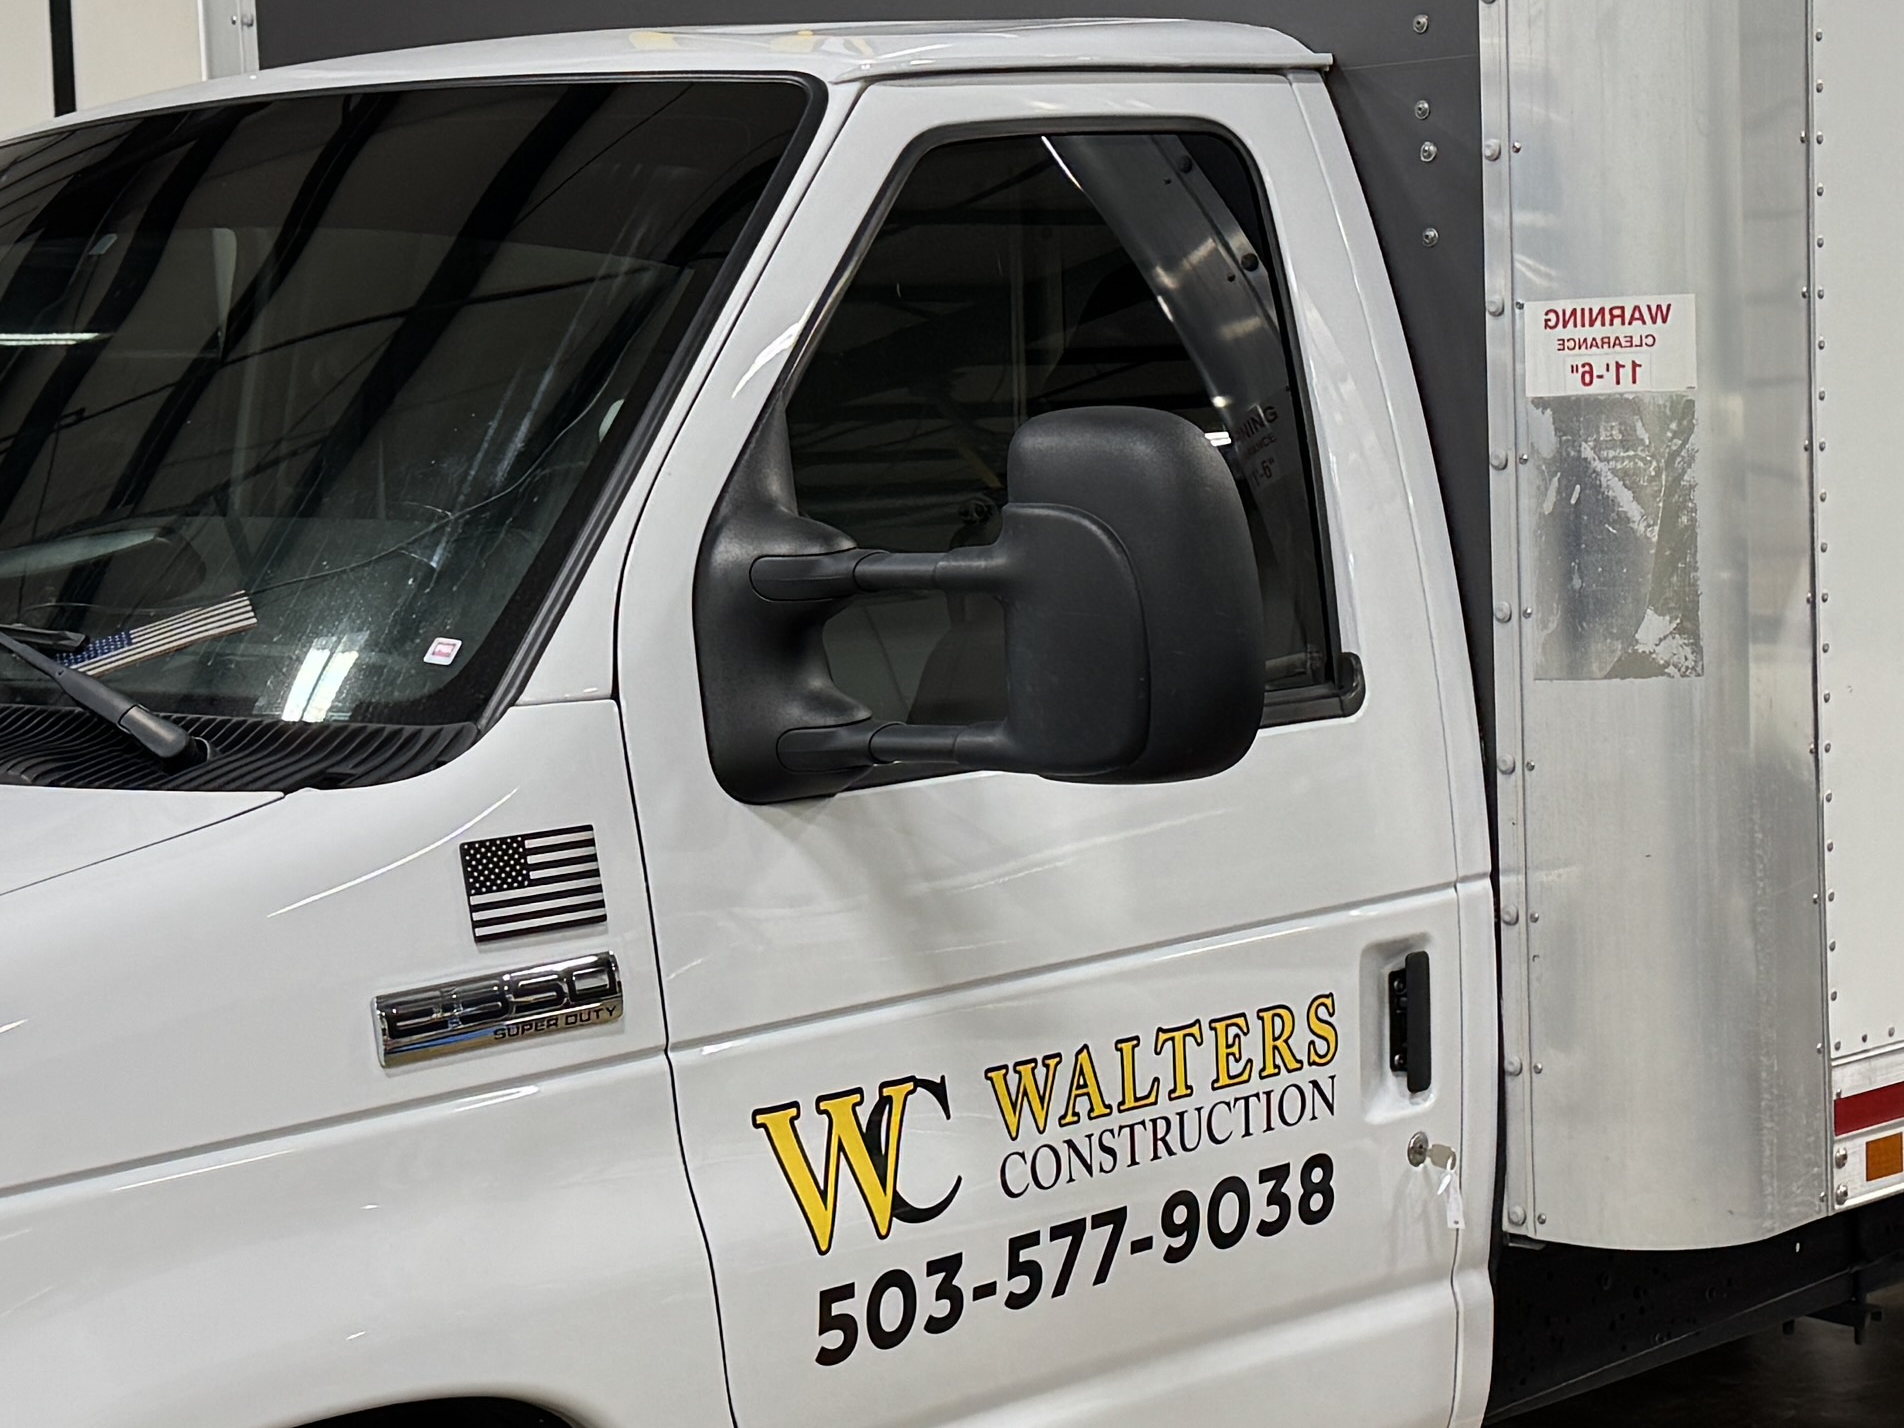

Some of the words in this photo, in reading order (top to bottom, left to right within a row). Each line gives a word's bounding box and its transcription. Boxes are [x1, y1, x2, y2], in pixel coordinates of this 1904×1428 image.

[492, 1015, 559, 1041] SUPER
[564, 1005, 618, 1026] DUTY
[984, 991, 1340, 1142] WALTERS
[751, 1073, 963, 1257] WC
[998, 1074, 1338, 1200] CONSTRUCTION
[814, 1152, 1336, 1368] 503-577-9038
